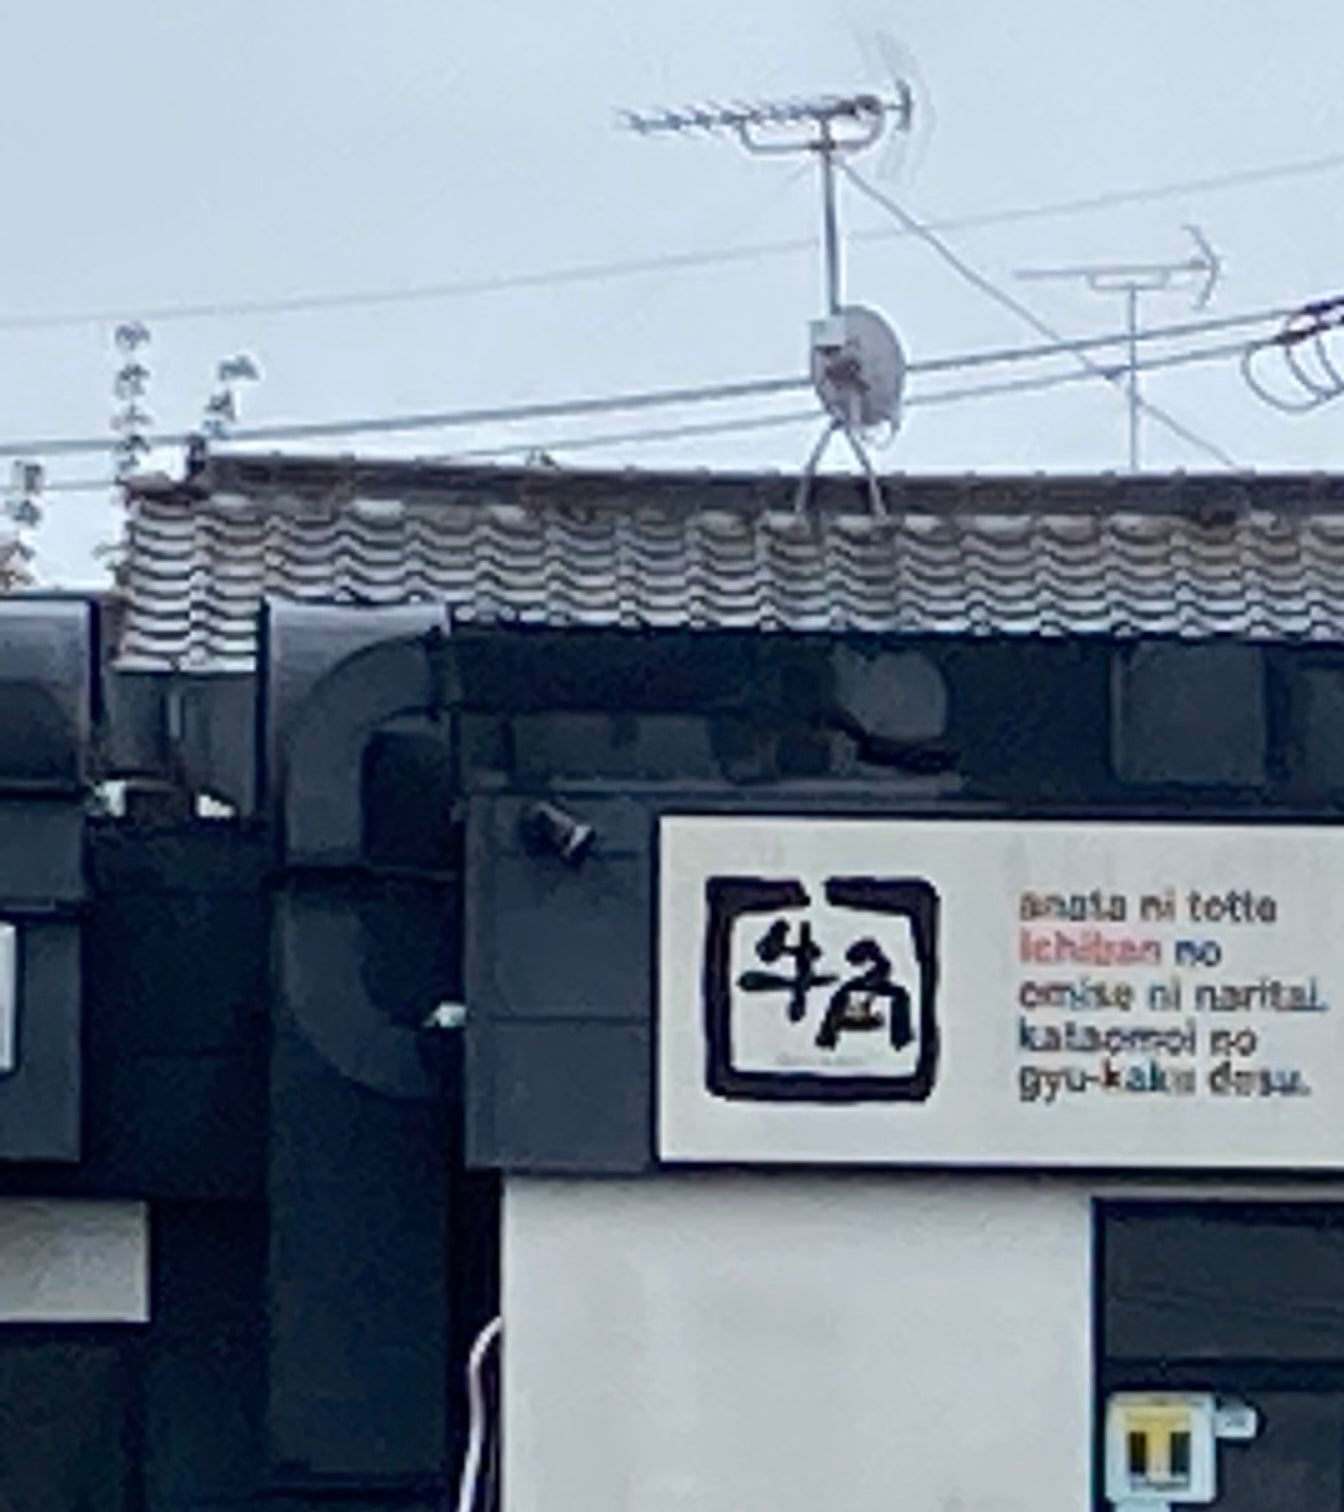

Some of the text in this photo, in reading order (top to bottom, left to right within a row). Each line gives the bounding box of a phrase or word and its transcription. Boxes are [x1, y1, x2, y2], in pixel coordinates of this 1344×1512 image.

[1139, 888, 1177, 923] ni
[1174, 939, 1222, 967] no
[1148, 975, 1182, 1012] ni
[1209, 1026, 1258, 1057] no
